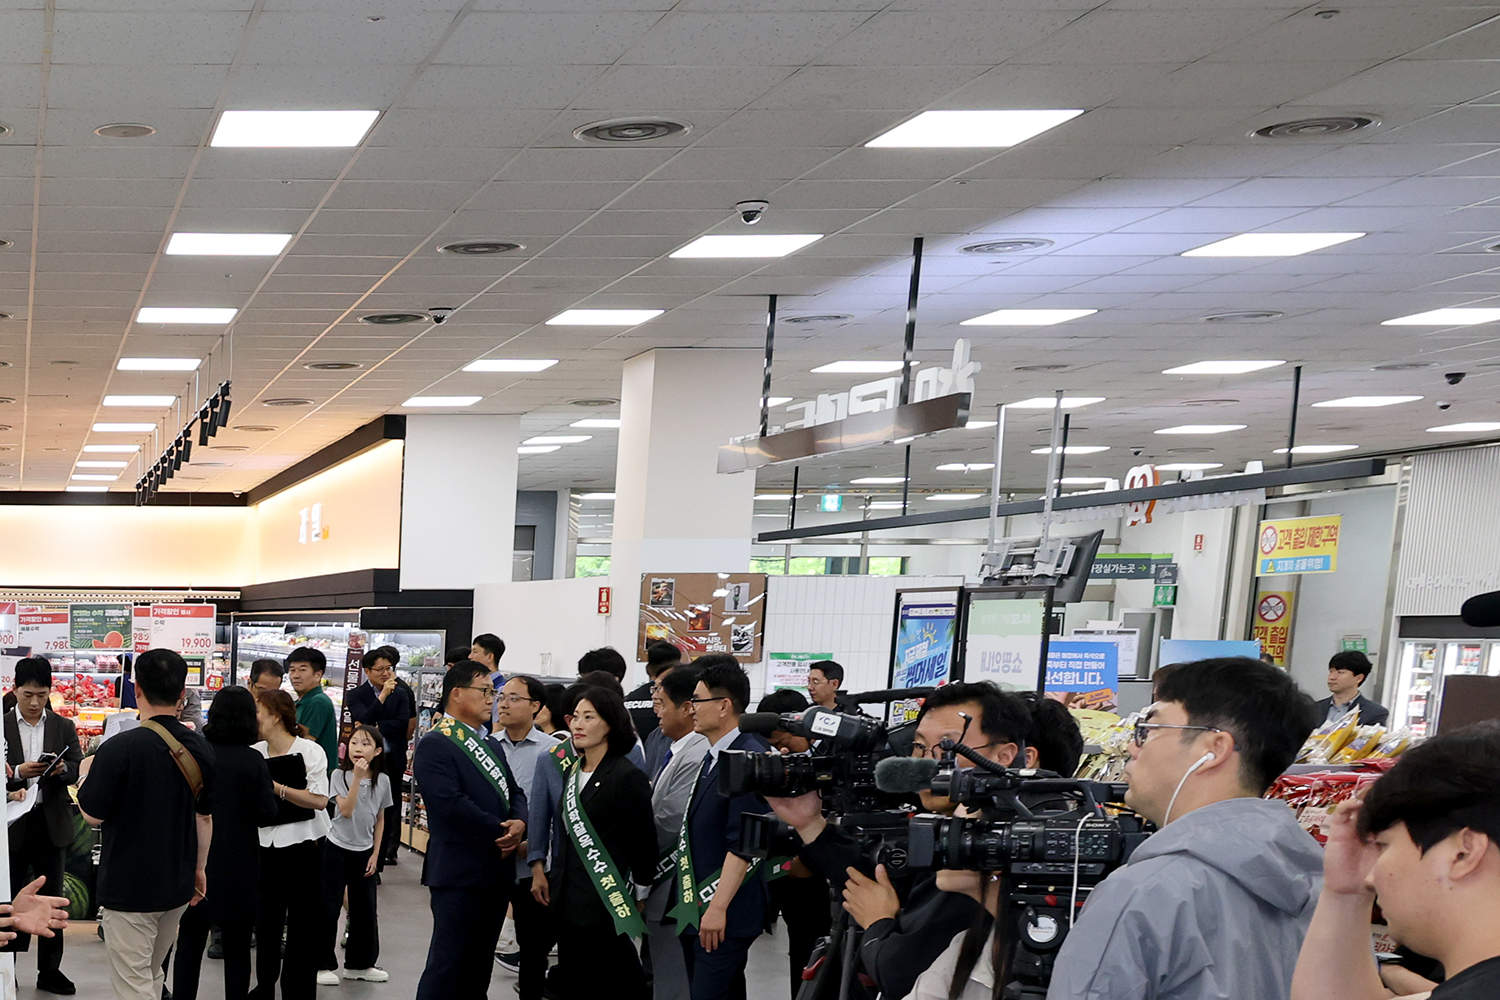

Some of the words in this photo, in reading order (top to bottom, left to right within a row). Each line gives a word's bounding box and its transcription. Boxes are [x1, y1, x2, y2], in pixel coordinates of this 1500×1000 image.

[1277, 528, 1293, 550] 고객
[1292, 526, 1308, 550] 출입
[153, 608, 180, 616] 가격할인
[1253, 626, 1269, 642] 고객
[1269, 625, 1288, 644] 출입
[181, 637, 212, 648] 19,900
[1068, 661, 1083, 670] 직접
[1083, 661, 1105, 670] 만들어
[623, 700, 654, 710] SECURI
[599, 873, 617, 890] 첫
[608, 890, 632, 918] 출하
